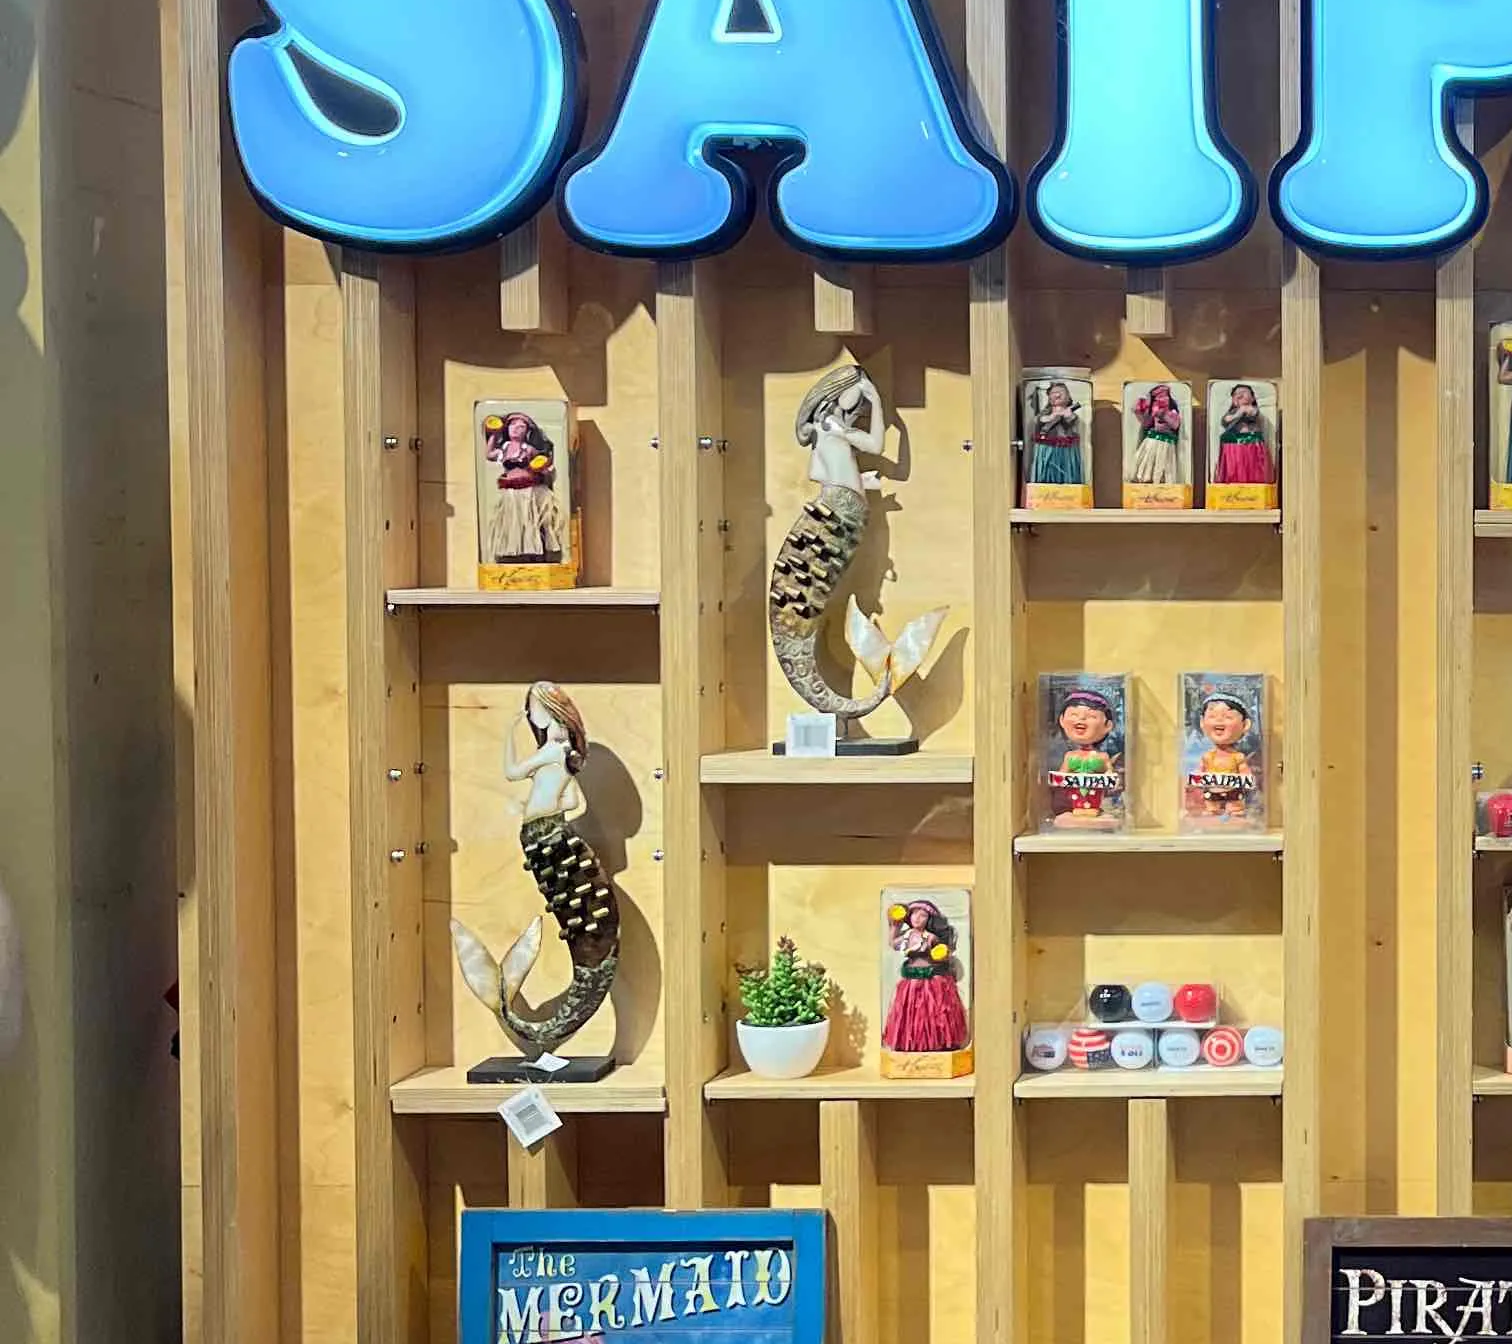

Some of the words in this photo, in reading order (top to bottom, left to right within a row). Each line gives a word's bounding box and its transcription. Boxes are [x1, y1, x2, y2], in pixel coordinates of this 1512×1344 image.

[1063, 775, 1117, 788] SAIPAN
[1202, 774, 1255, 788] SAIPAN
[509, 1245, 576, 1279] The
